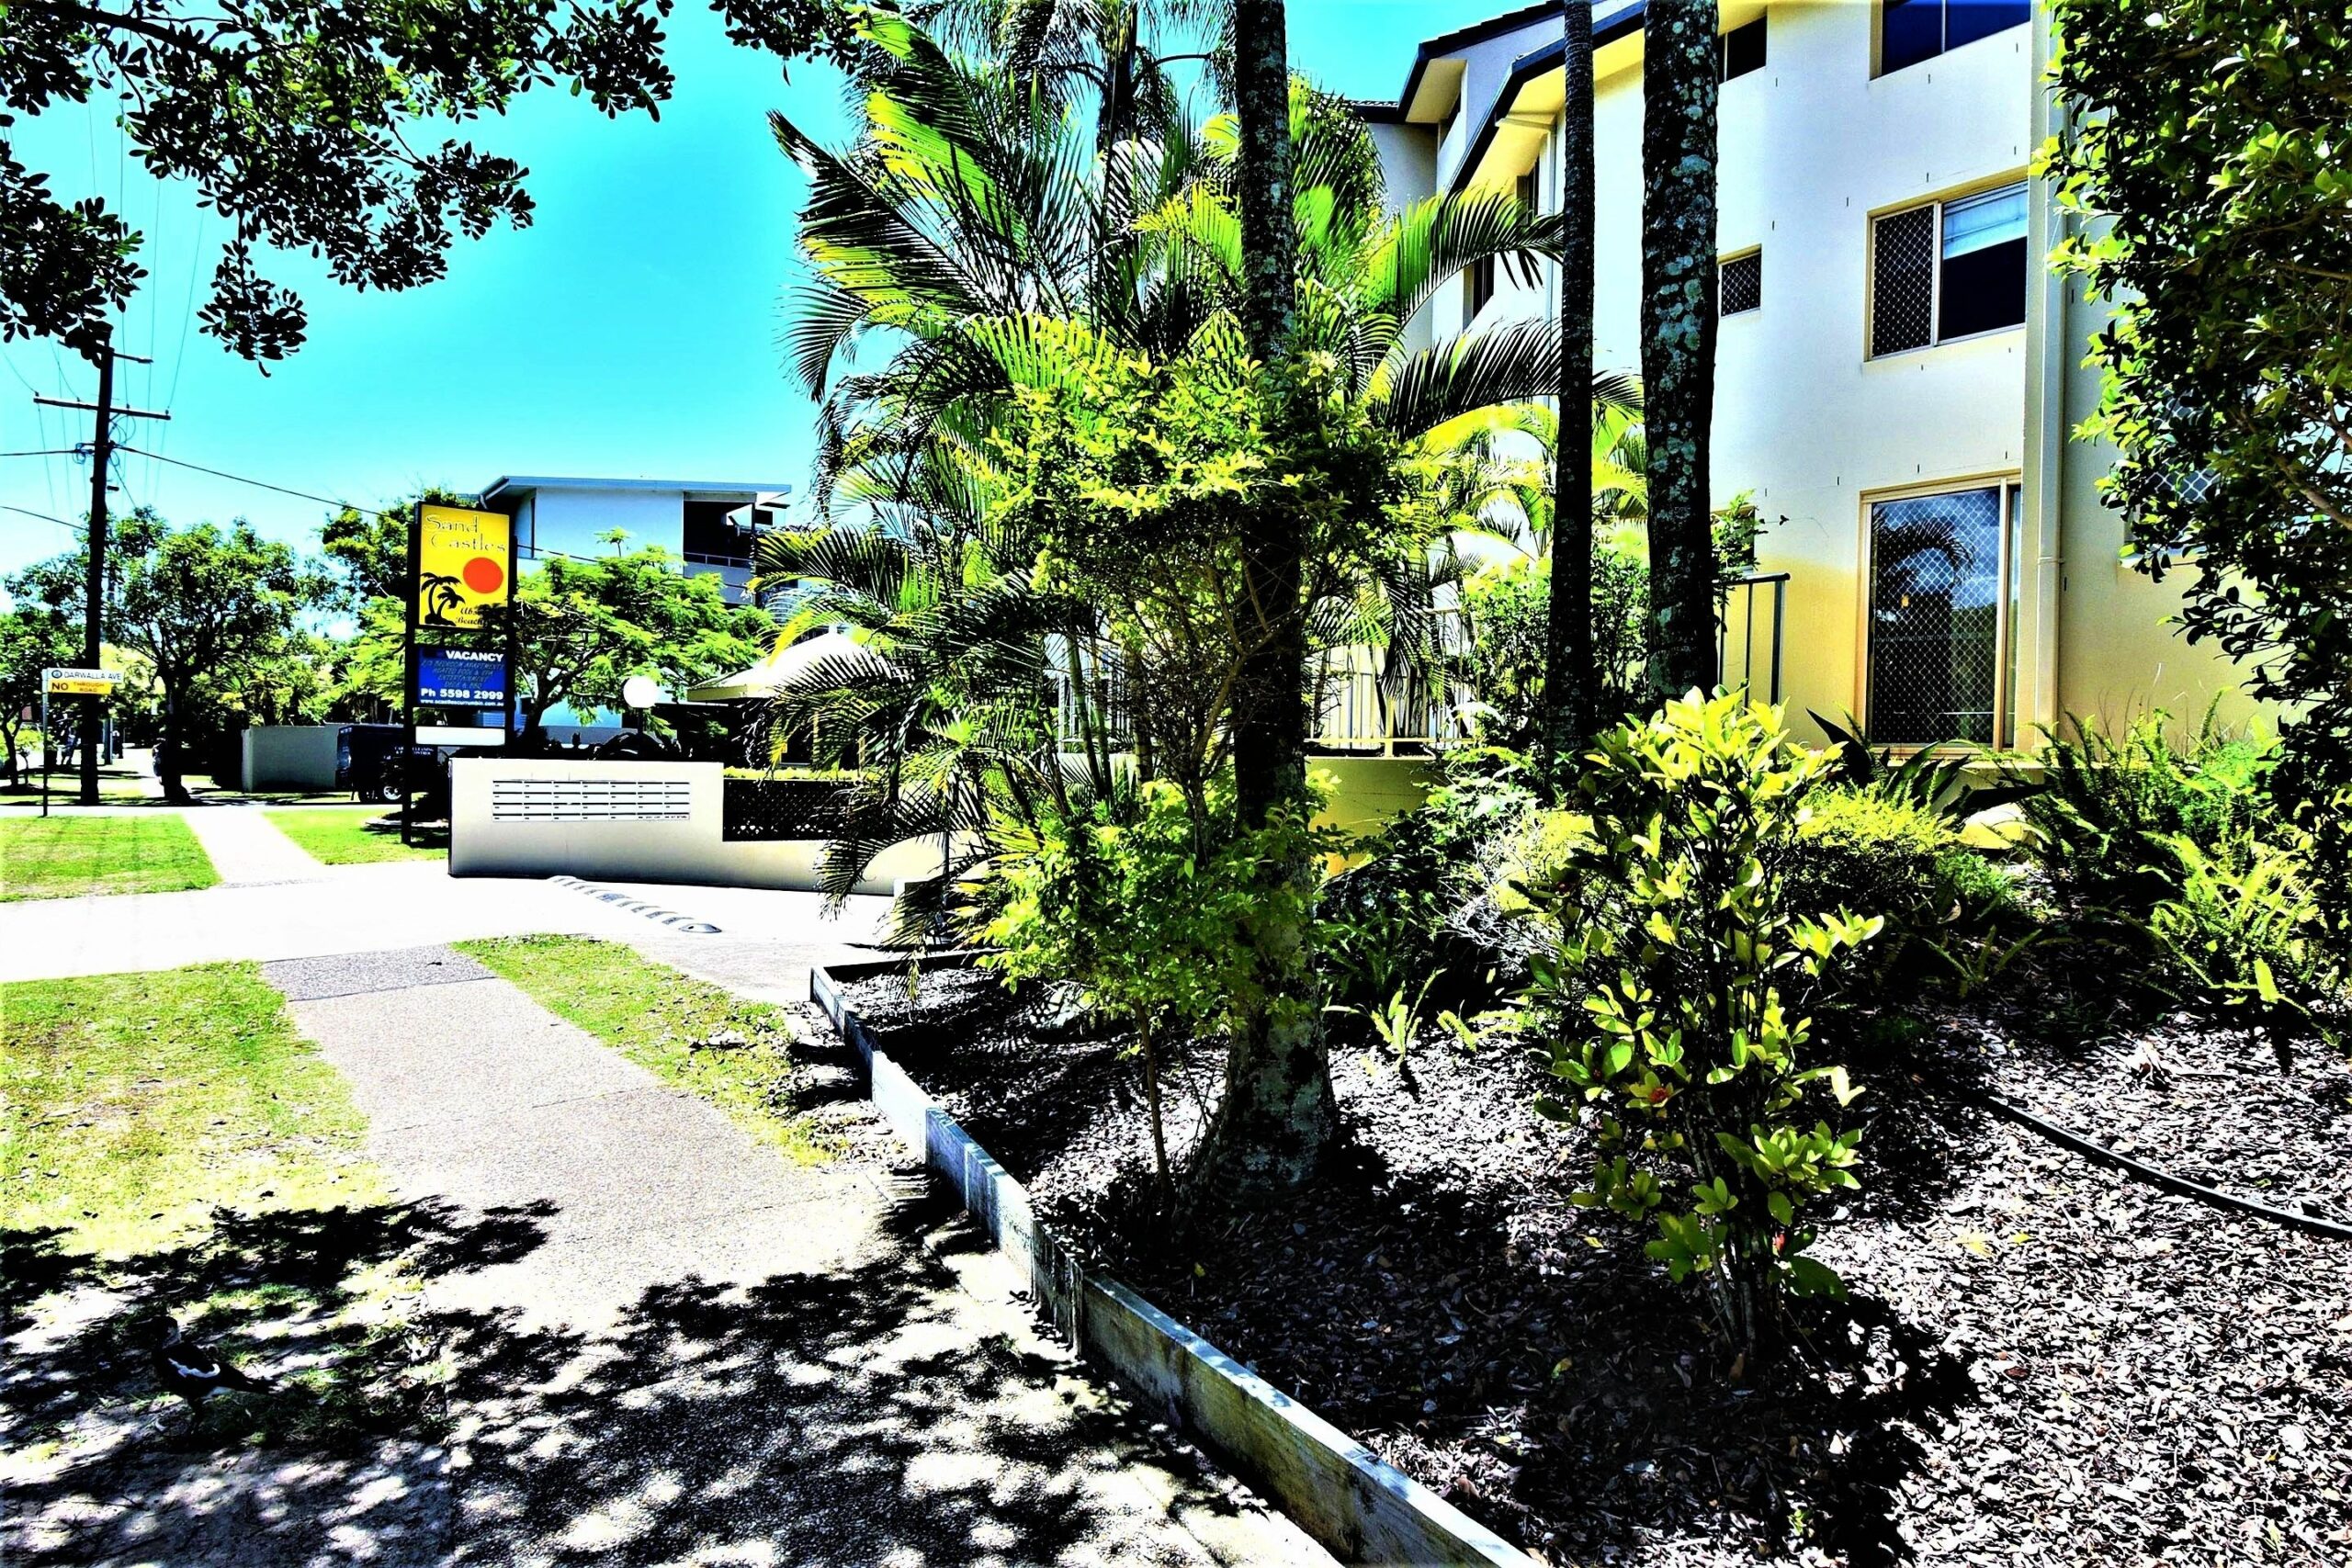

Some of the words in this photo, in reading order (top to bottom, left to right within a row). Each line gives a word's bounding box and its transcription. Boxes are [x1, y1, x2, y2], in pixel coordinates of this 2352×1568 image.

[424, 514, 478, 533] Sand
[431, 533, 505, 551] Castles
[446, 650, 504, 662] VACANCY
[64, 671, 105, 680] DARWALLA
[52, 682, 69, 691] NO
[421, 688, 436, 697] Ph
[440, 689, 470, 699] 5598
[474, 691, 504, 700] 2999
